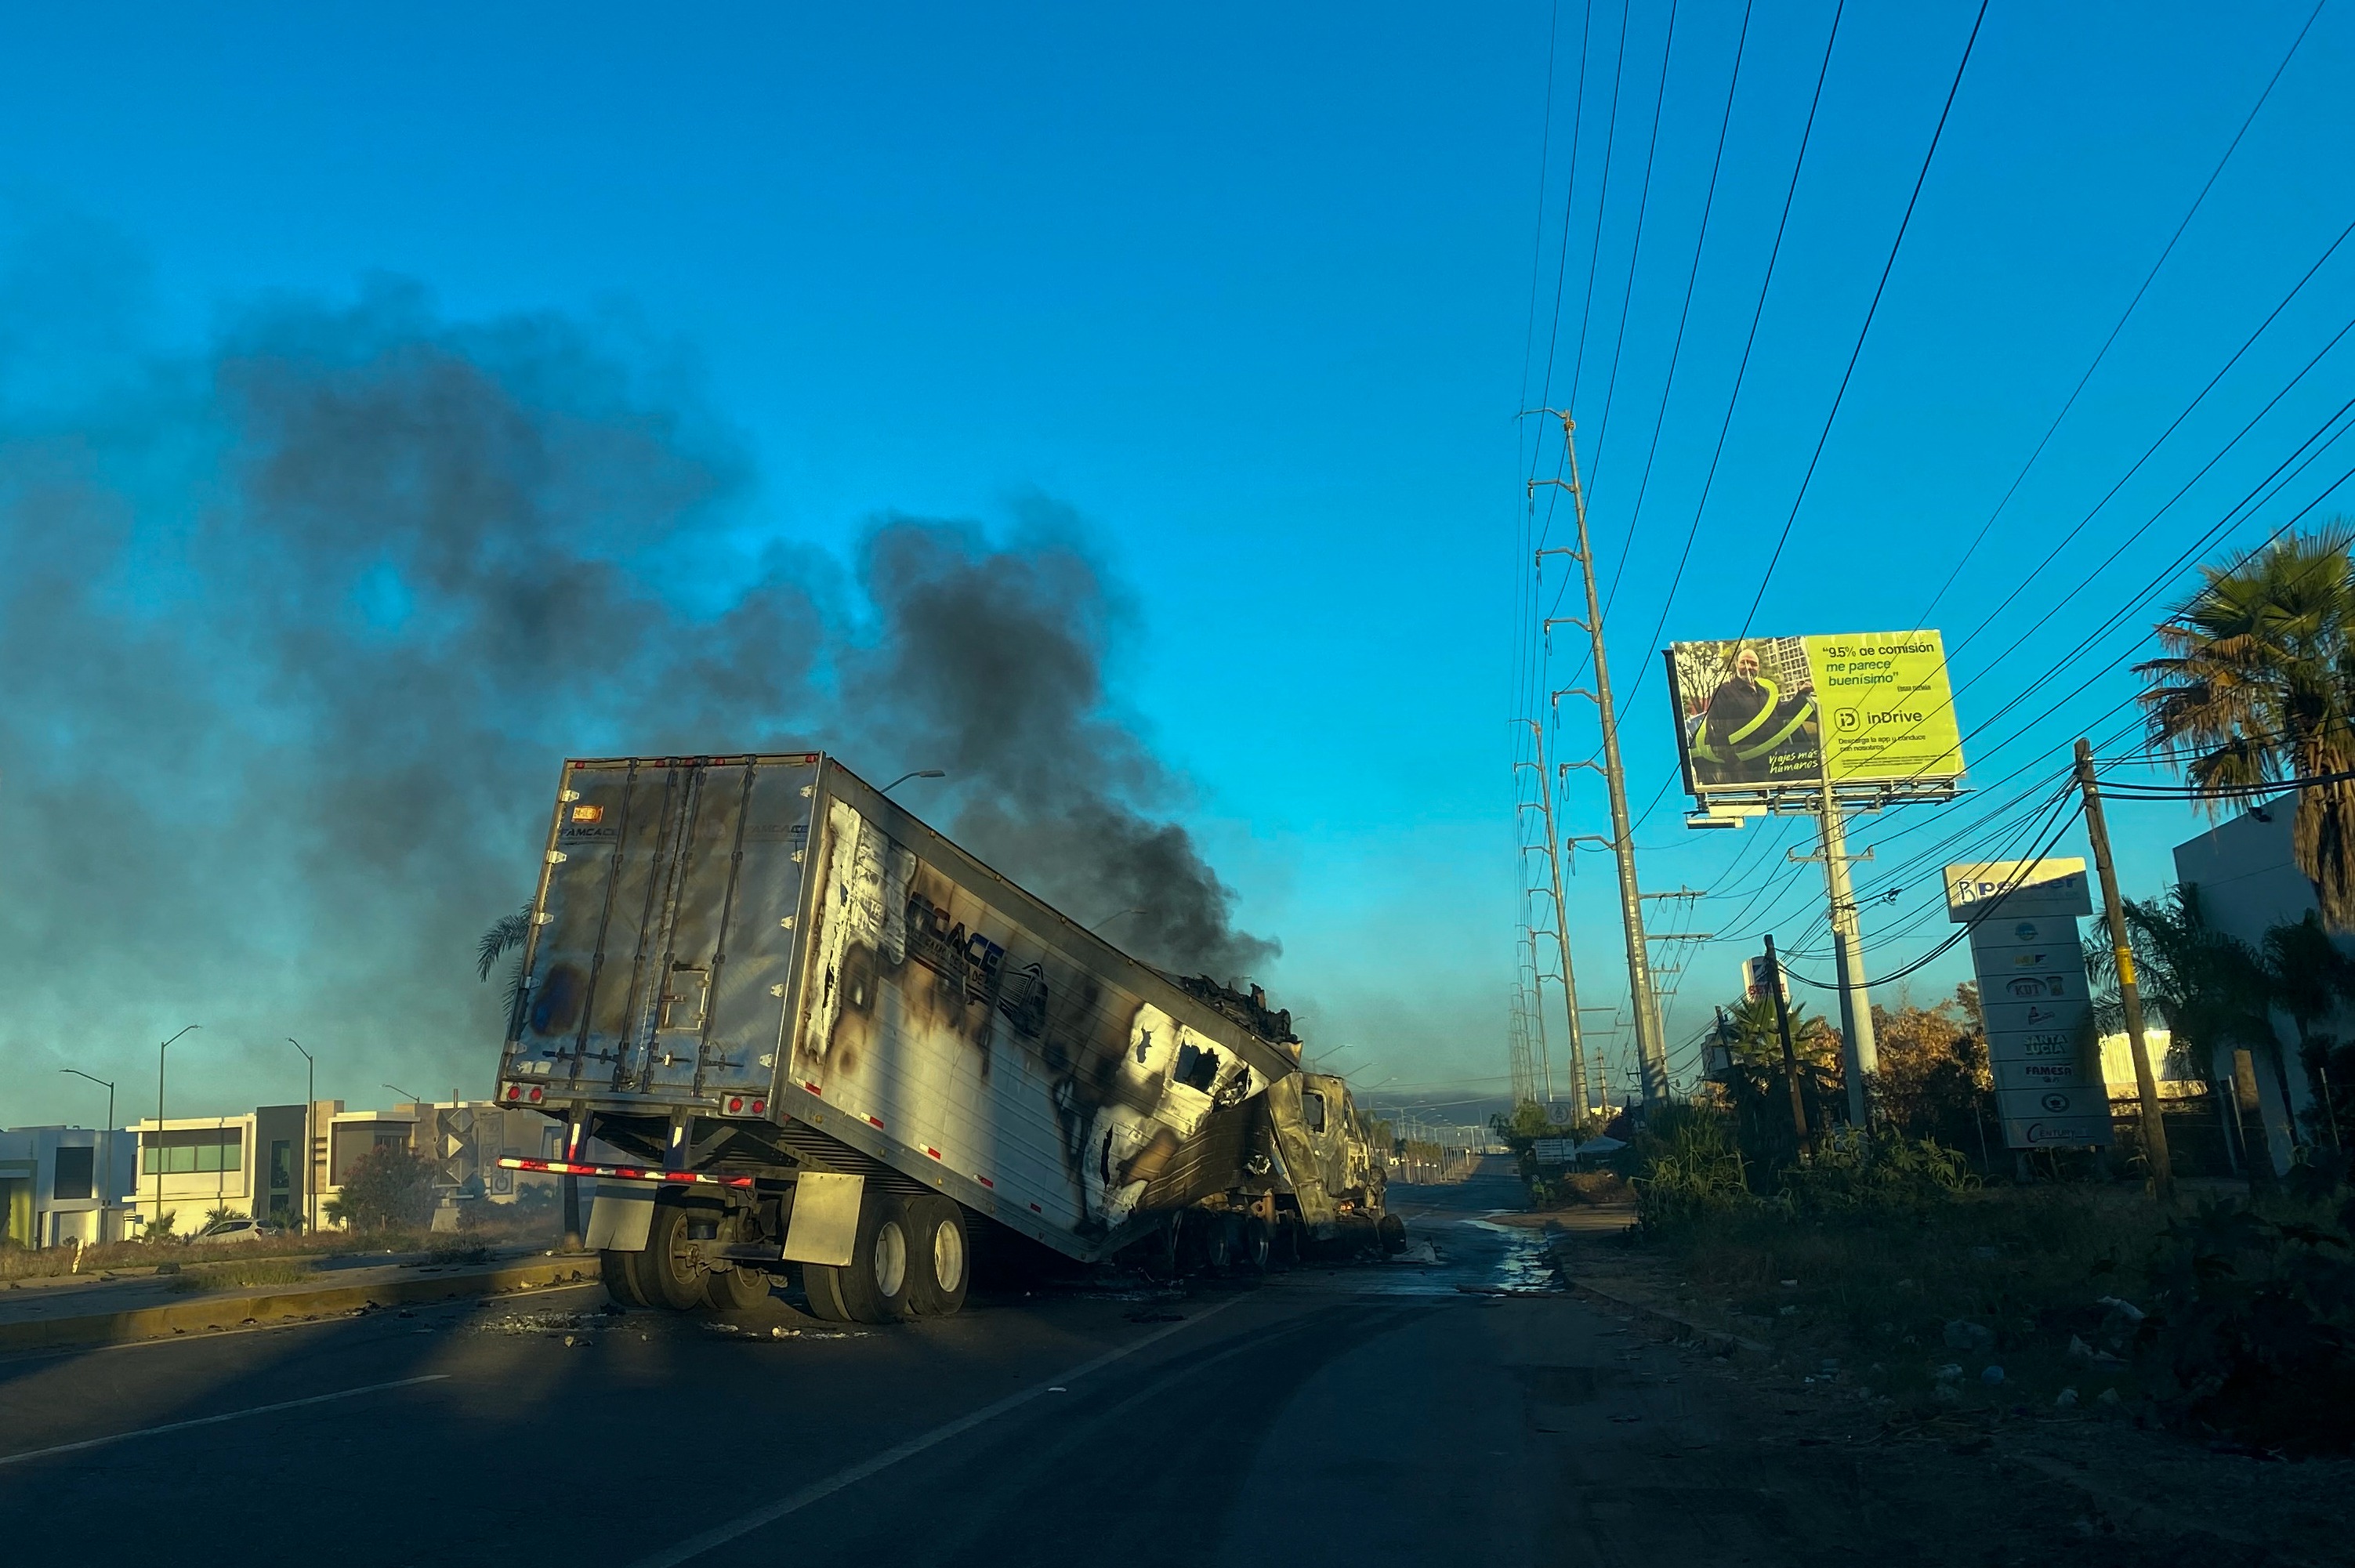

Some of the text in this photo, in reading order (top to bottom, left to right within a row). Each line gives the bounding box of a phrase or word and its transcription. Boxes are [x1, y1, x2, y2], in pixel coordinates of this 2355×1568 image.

[1878, 642, 1935, 655] comisión
[1826, 660, 1891, 674] me parece
[1866, 709, 1922, 725] inDrive
[1770, 759, 1819, 774] humanos
[2023, 1034, 2067, 1045] SANTA
[2023, 1043, 2066, 1055] LUCIA
[2025, 1066, 2073, 1076] FAMESA
[2027, 1122, 2076, 1143] CENTURY
